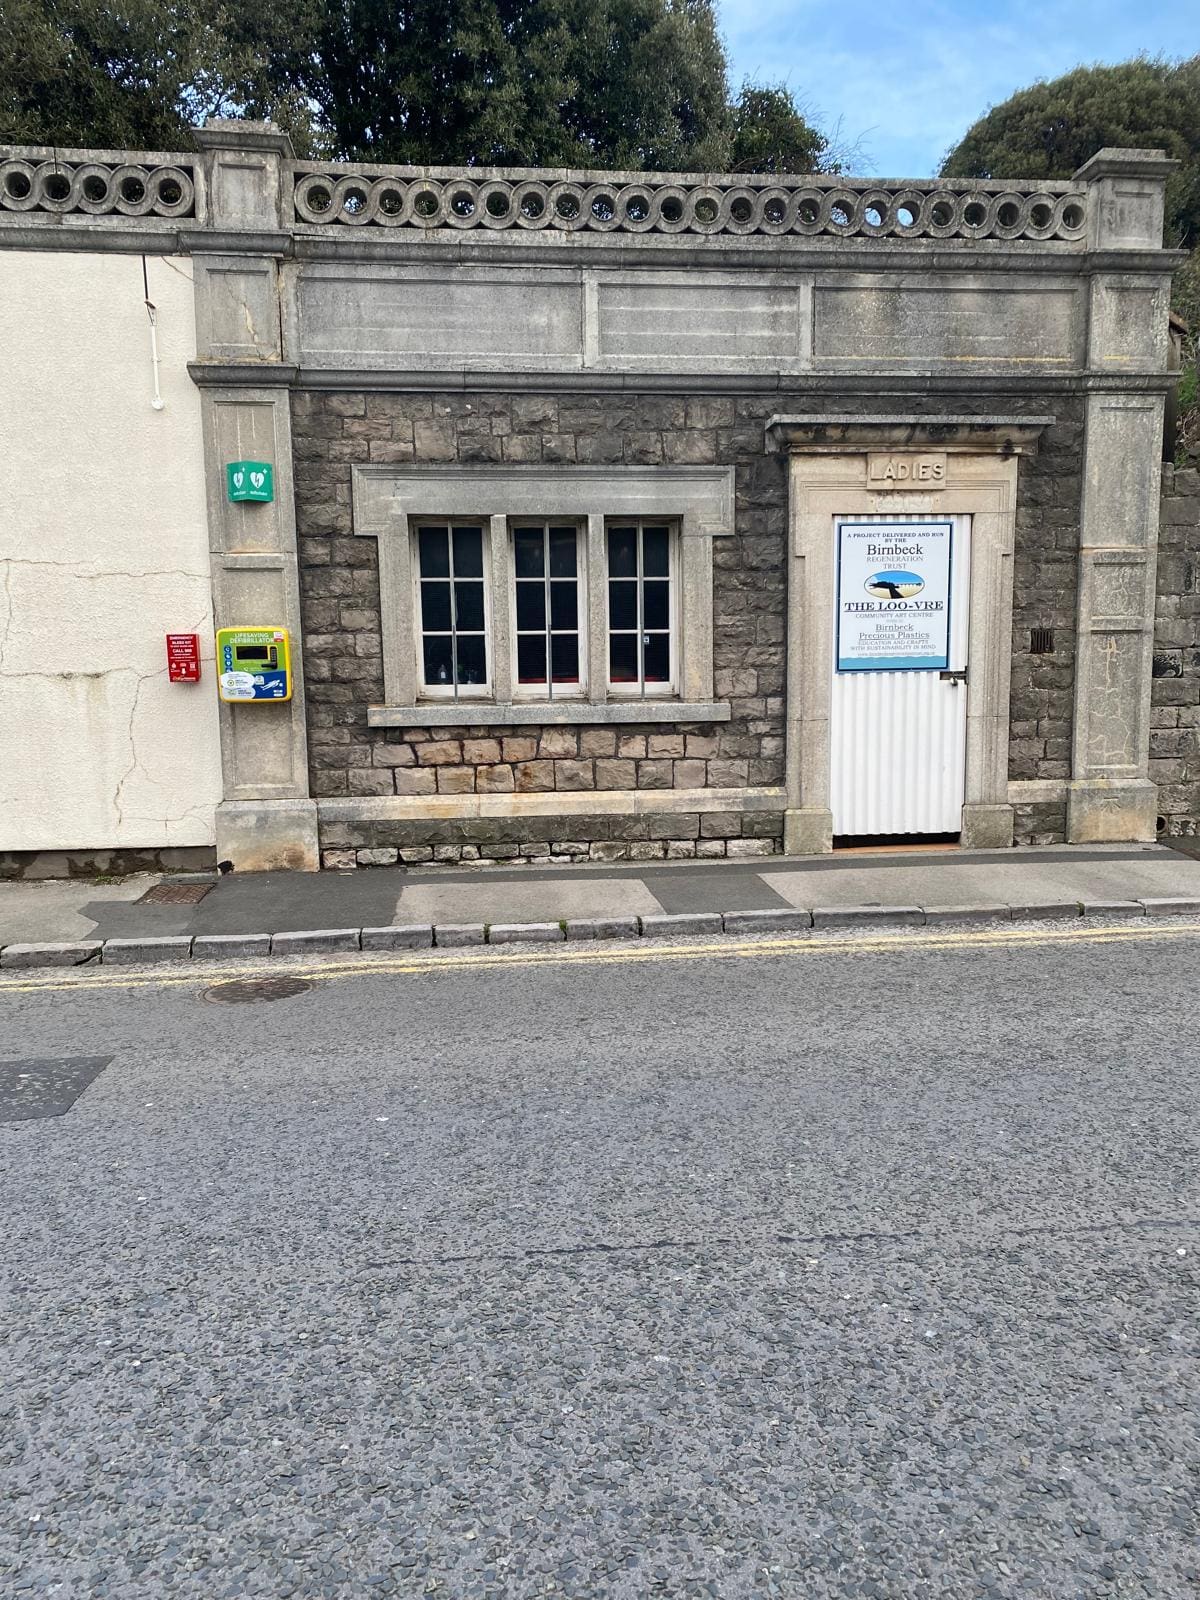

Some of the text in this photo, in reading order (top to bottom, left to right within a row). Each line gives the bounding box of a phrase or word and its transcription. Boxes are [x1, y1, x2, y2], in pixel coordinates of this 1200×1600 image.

[870, 462, 944, 480] LADIES
[867, 544, 923, 555] Birnbeck
[844, 601, 944, 611] THE LOO-VRE
[875, 623, 914, 631] Birnbeck
[897, 631, 930, 639] Plastics
